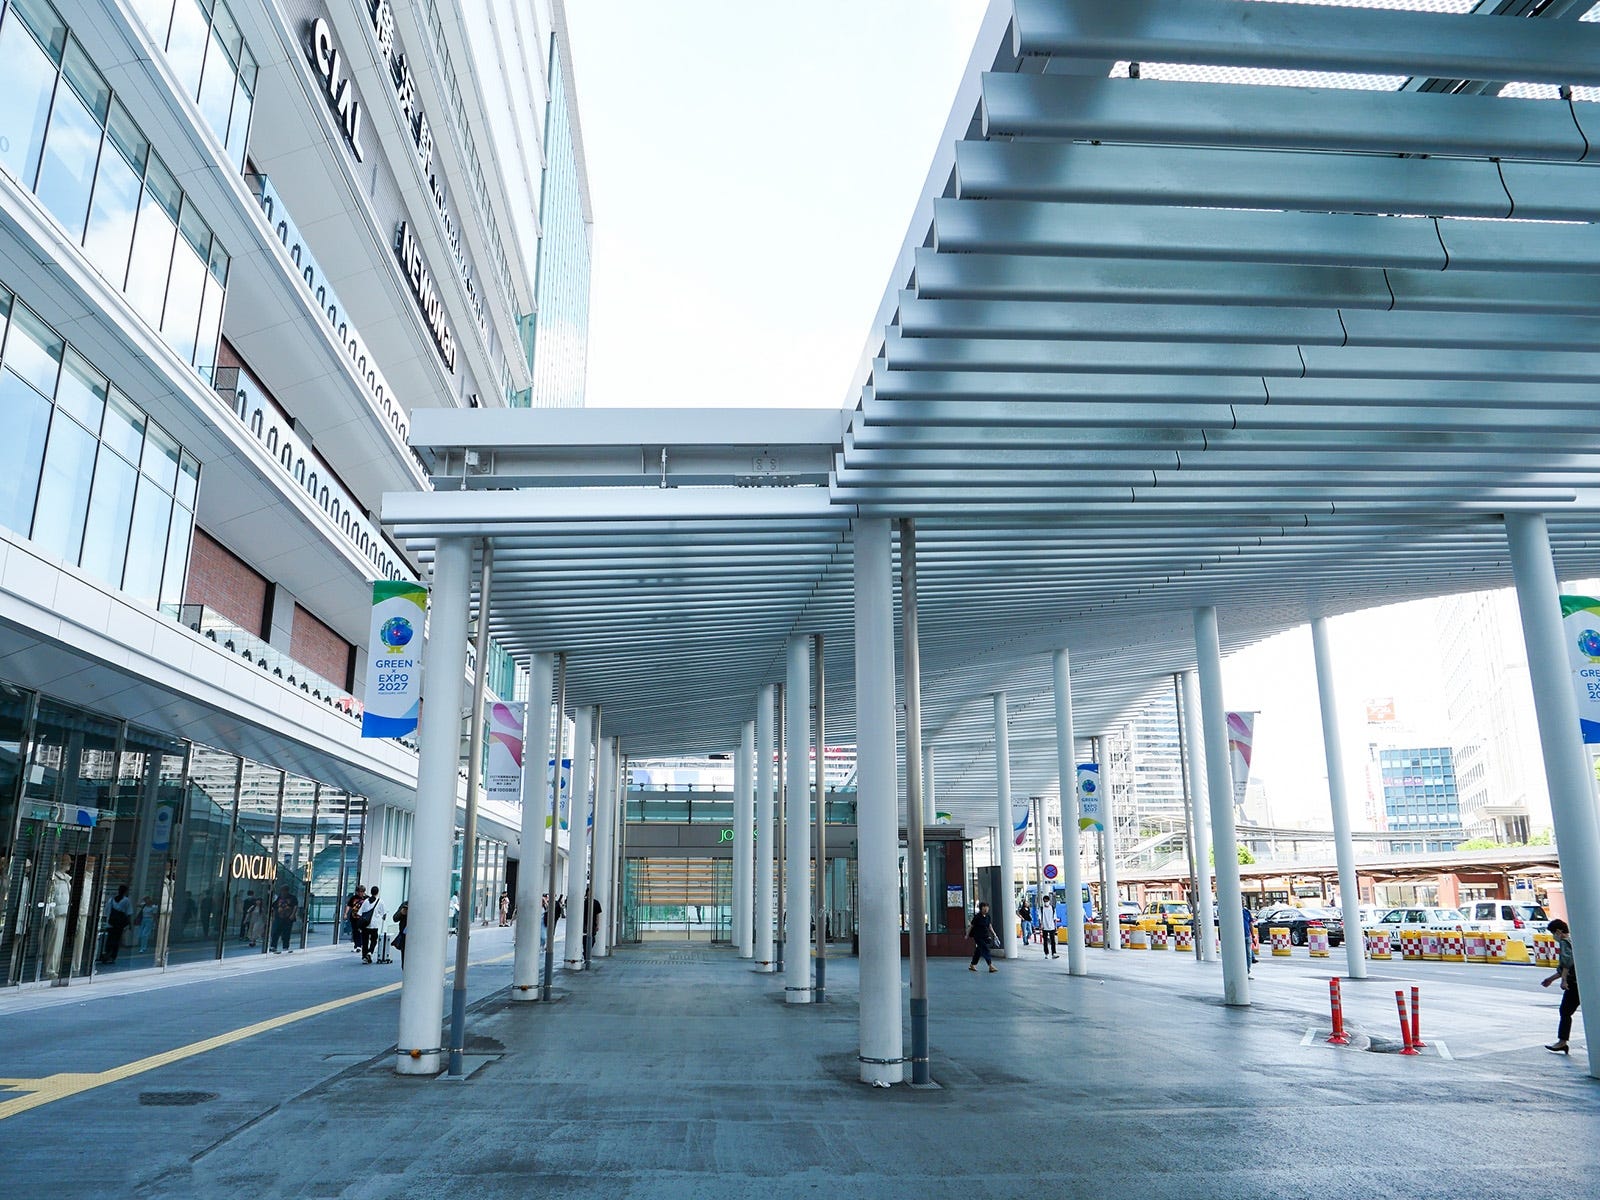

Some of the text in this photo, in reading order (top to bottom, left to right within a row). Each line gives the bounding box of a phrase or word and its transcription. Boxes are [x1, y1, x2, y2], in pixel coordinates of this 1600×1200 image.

[375, 659, 413, 668] GREEN
[379, 674, 409, 682] EXPO
[378, 682, 408, 691] 2027
